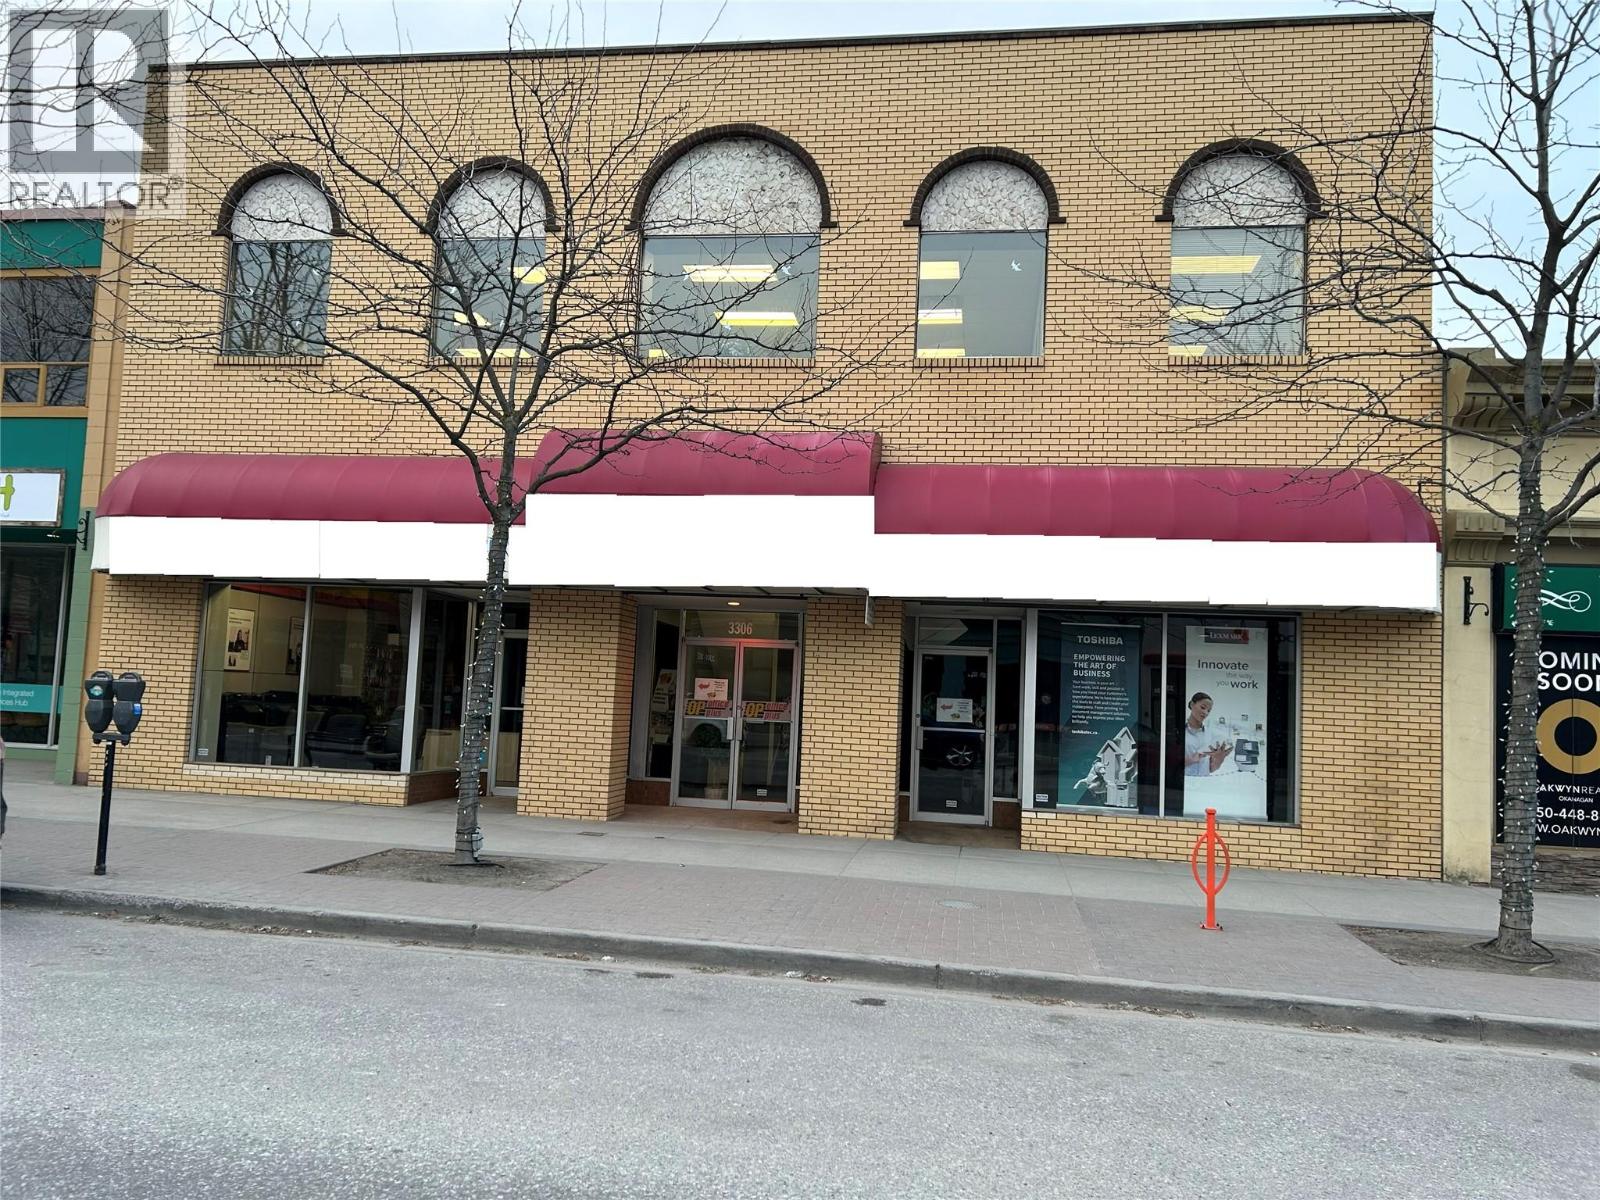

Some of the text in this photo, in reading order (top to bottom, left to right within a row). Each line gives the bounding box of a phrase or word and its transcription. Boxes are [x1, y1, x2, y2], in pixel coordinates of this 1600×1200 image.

[728, 621, 753, 635] 3306
[1076, 635, 1124, 645] TOSHIBA
[1073, 653, 1126, 662] EMPOWERING
[1073, 661, 1089, 669] THE
[1106, 662, 1117, 670] OF
[1197, 659, 1249, 671] Innovate
[1073, 669, 1111, 678] BUSINESS
[1215, 680, 1259, 689] you work
[1537, 672, 1600, 692] SOO
[746, 702, 765, 717] OP
[1558, 795, 1594, 803] OKANAGAN
